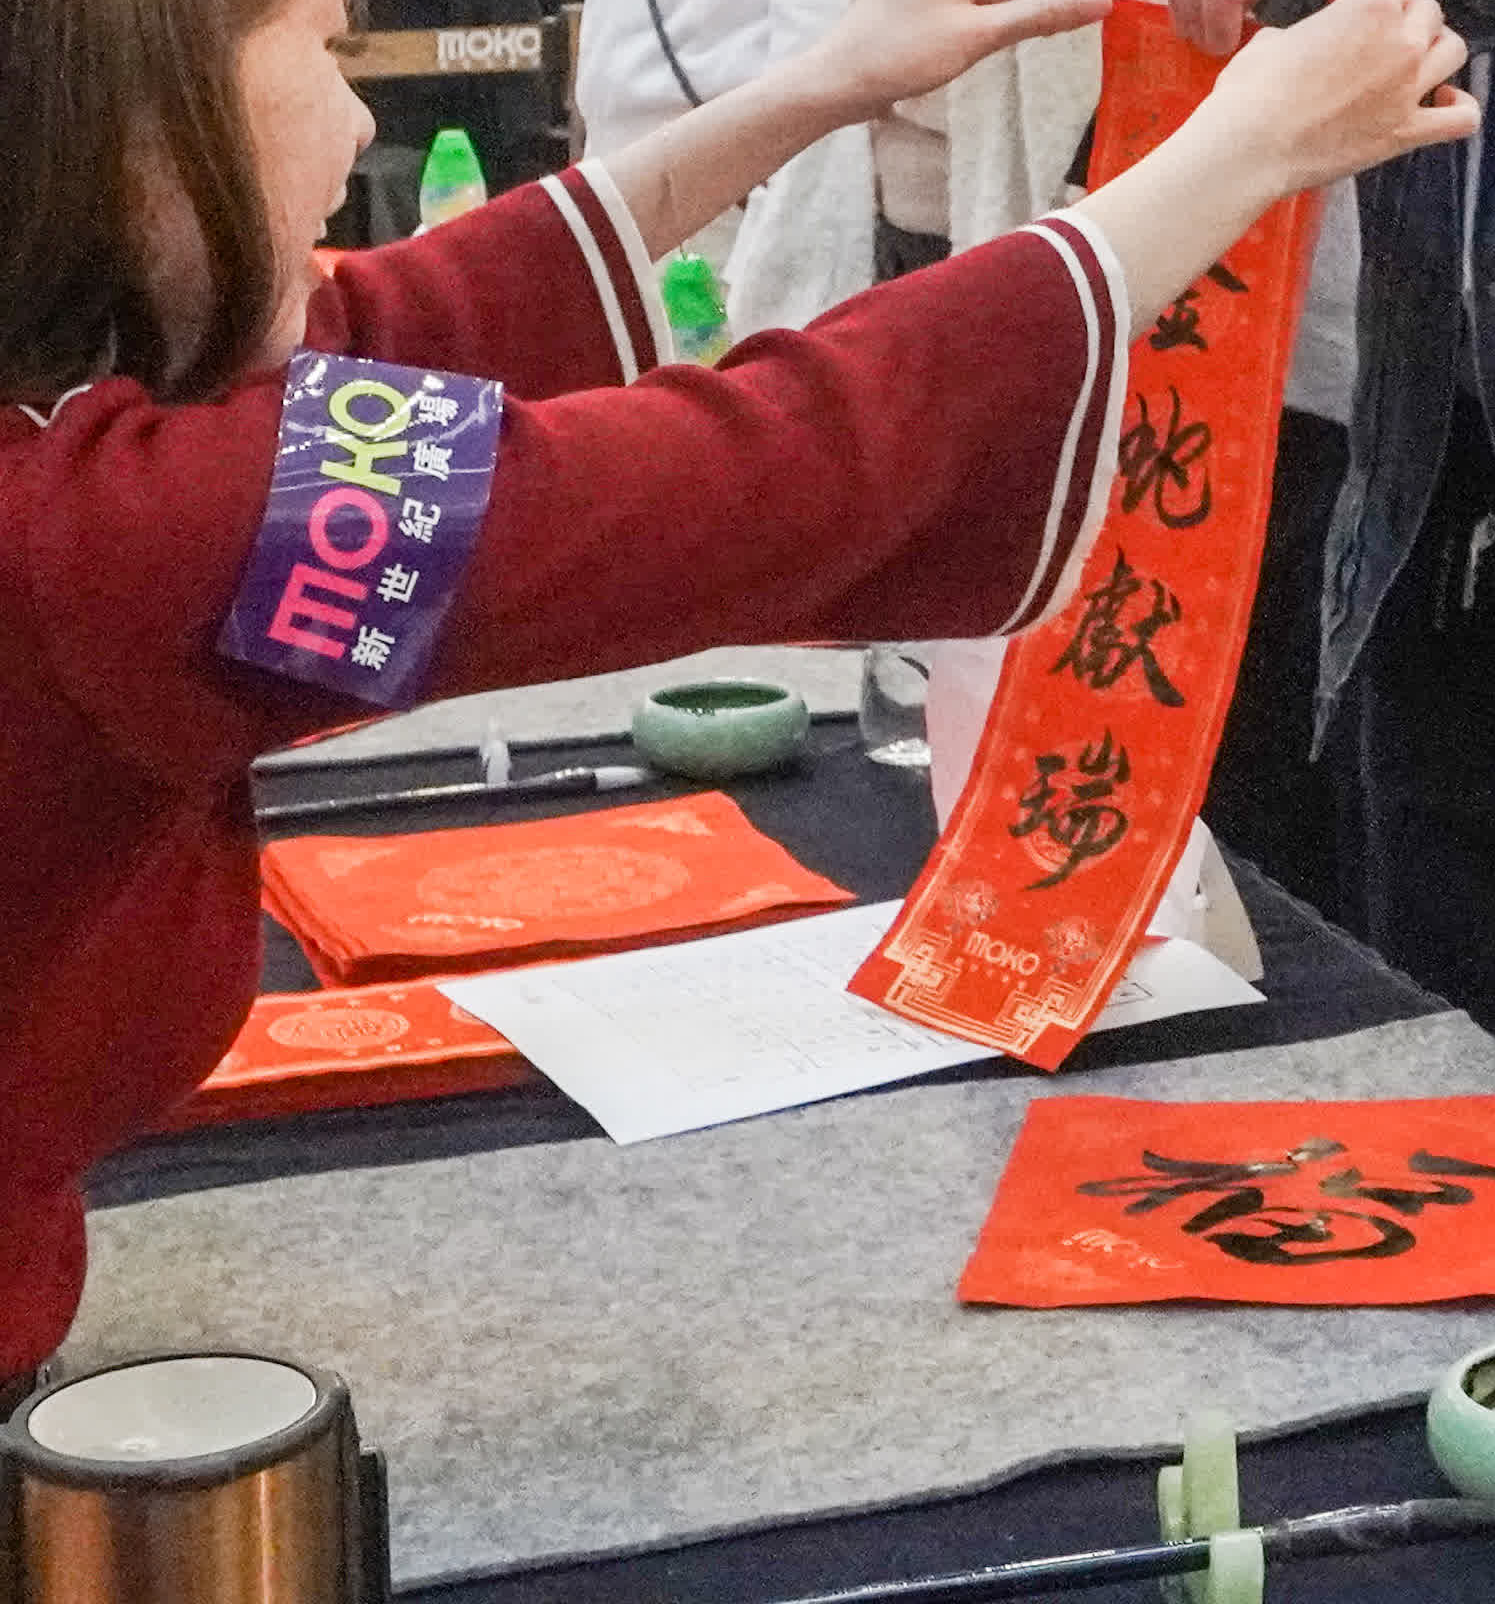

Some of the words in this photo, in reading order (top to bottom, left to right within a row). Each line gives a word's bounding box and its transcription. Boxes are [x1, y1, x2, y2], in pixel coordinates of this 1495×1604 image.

[437, 27, 542, 62] MOKO
[266, 379, 414, 660] MOKO
[351, 392, 460, 671] 新世紀廣場
[965, 931, 1041, 976] MOKO
